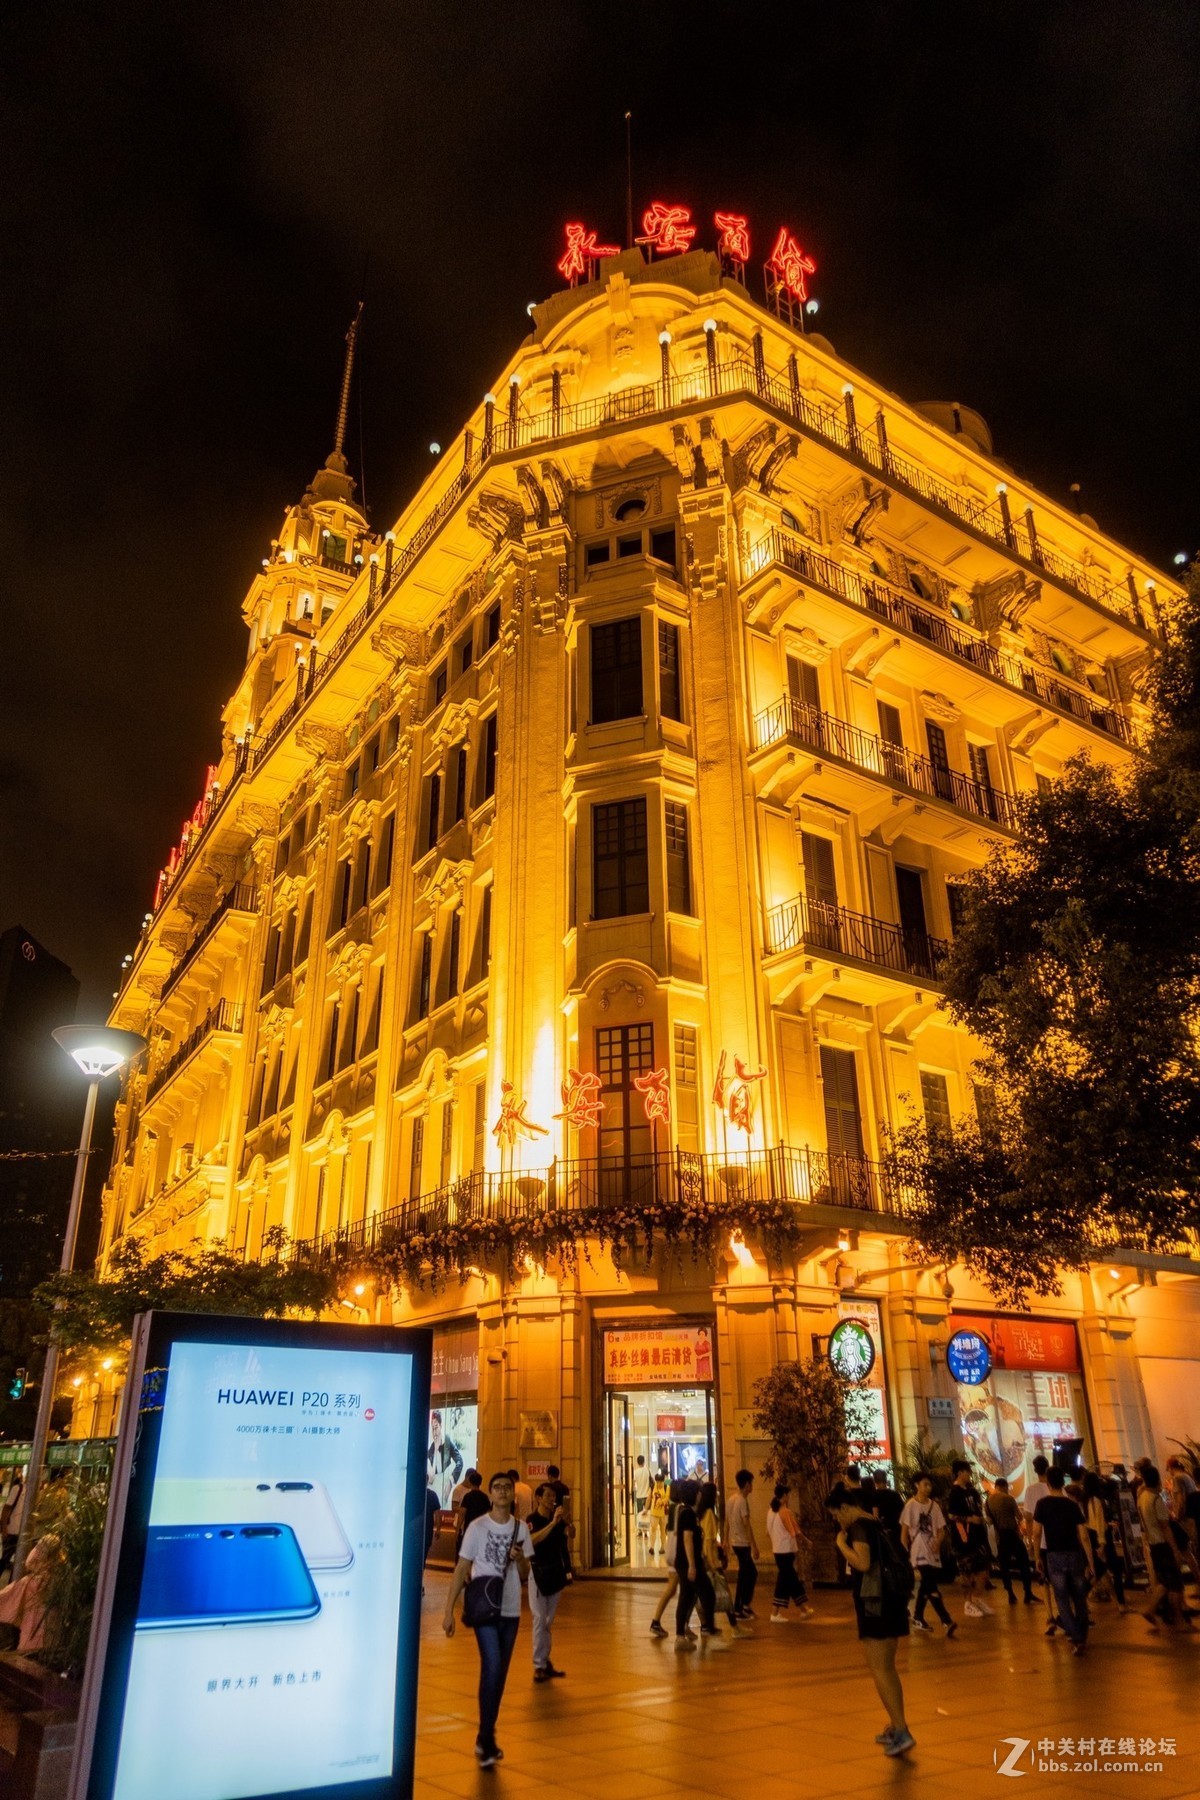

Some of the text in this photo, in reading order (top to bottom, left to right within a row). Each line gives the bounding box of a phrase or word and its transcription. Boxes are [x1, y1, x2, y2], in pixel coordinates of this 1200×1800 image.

[217, 1388, 361, 1409] HUAWEI P20 系列
[207, 1670, 321, 1692] 眼界大开 新色上市
